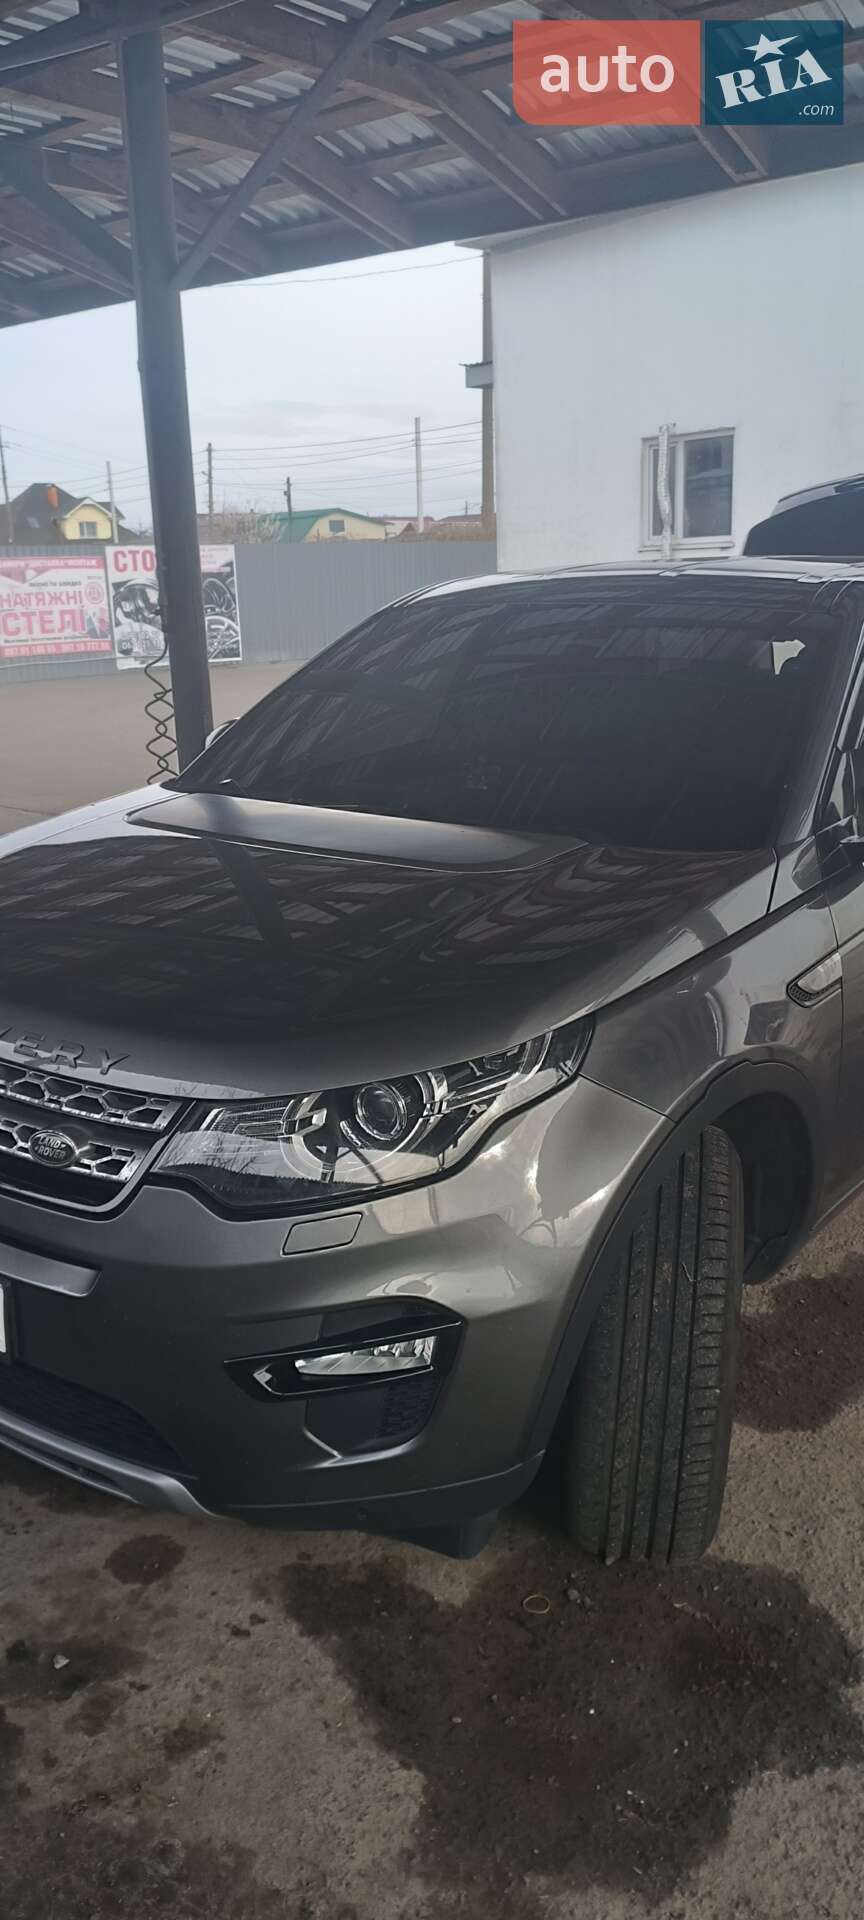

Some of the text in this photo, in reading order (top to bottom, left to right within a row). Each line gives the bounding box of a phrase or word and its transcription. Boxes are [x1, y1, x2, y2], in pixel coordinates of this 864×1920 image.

[114, 550, 157, 573] СТО
[0, 590, 83, 609] НАТЯЖНІ
[2, 608, 86, 636] СТЕЛІ
[38, 1135, 61, 1149] LAND
[39, 1145, 66, 1159] ROVER
